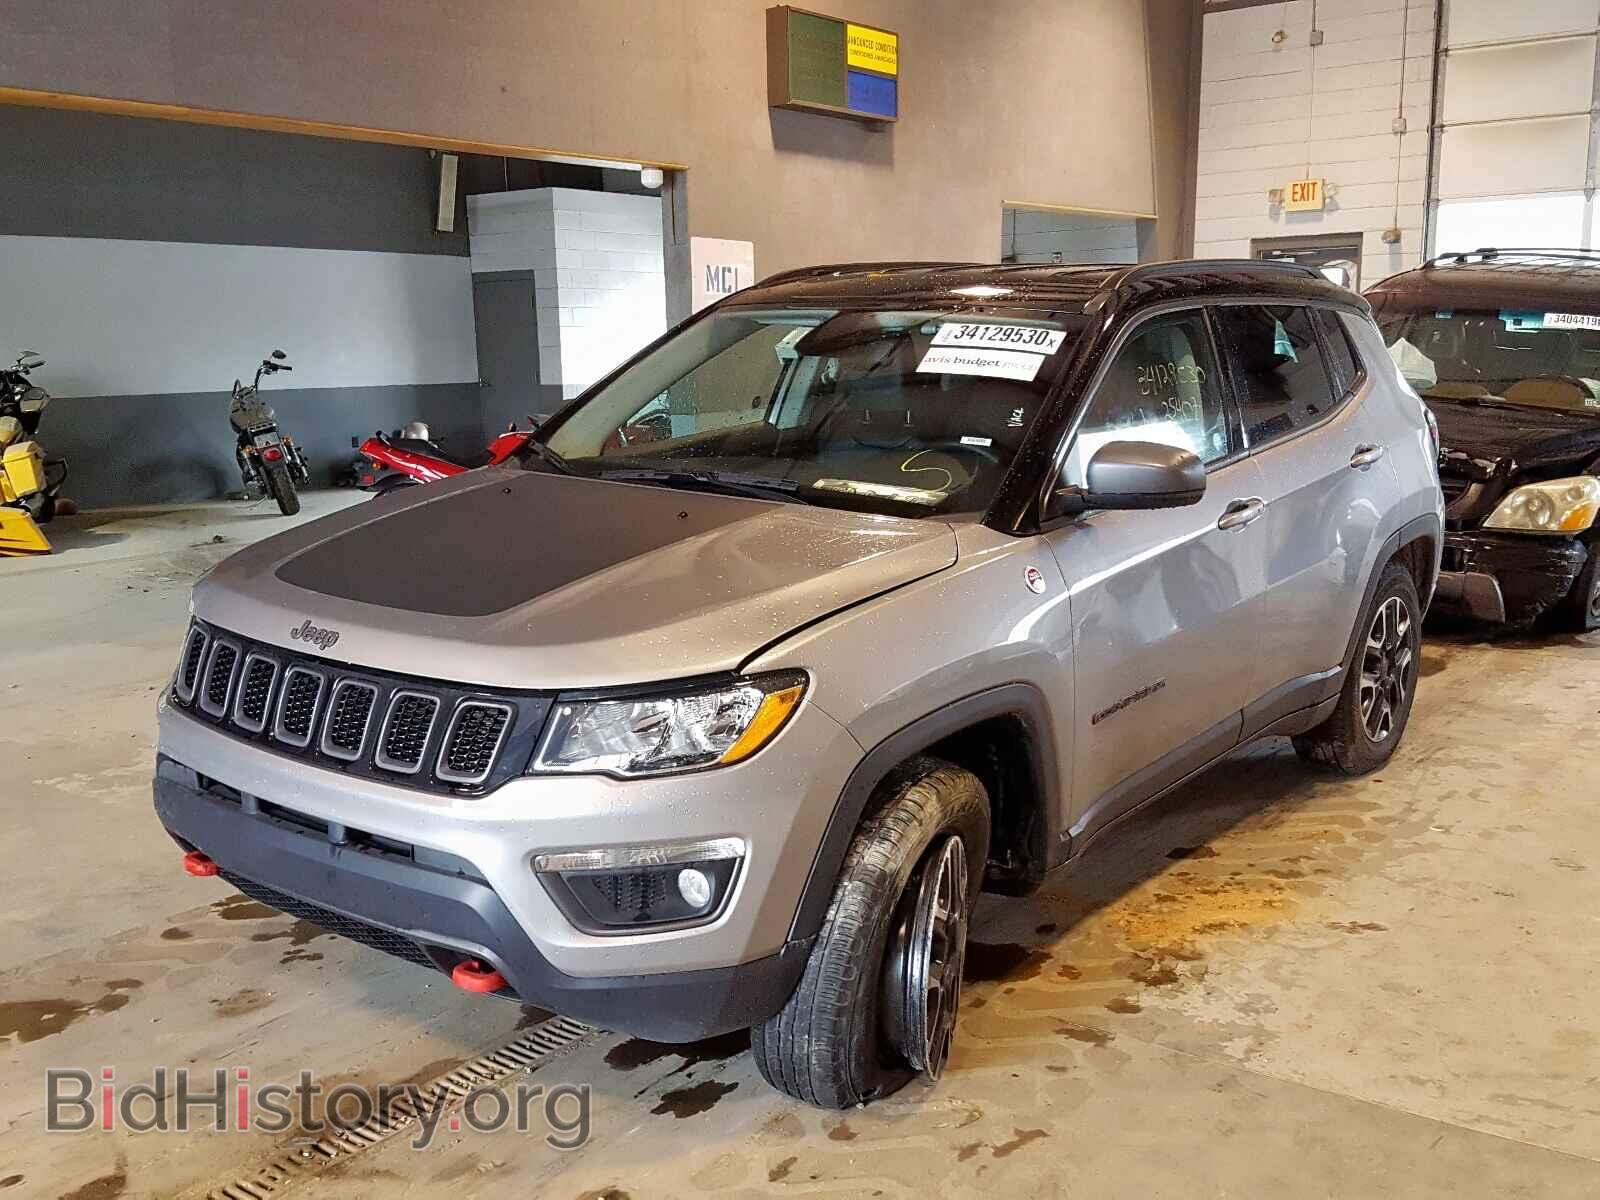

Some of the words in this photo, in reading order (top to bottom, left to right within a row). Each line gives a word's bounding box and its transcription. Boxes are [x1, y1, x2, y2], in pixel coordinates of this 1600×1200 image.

[1292, 182, 1318, 202] EXIT
[954, 325, 1049, 346] 34129530
[924, 355, 951, 364] avis
[953, 356, 1000, 368] budget
[290, 619, 340, 650] Jeep
